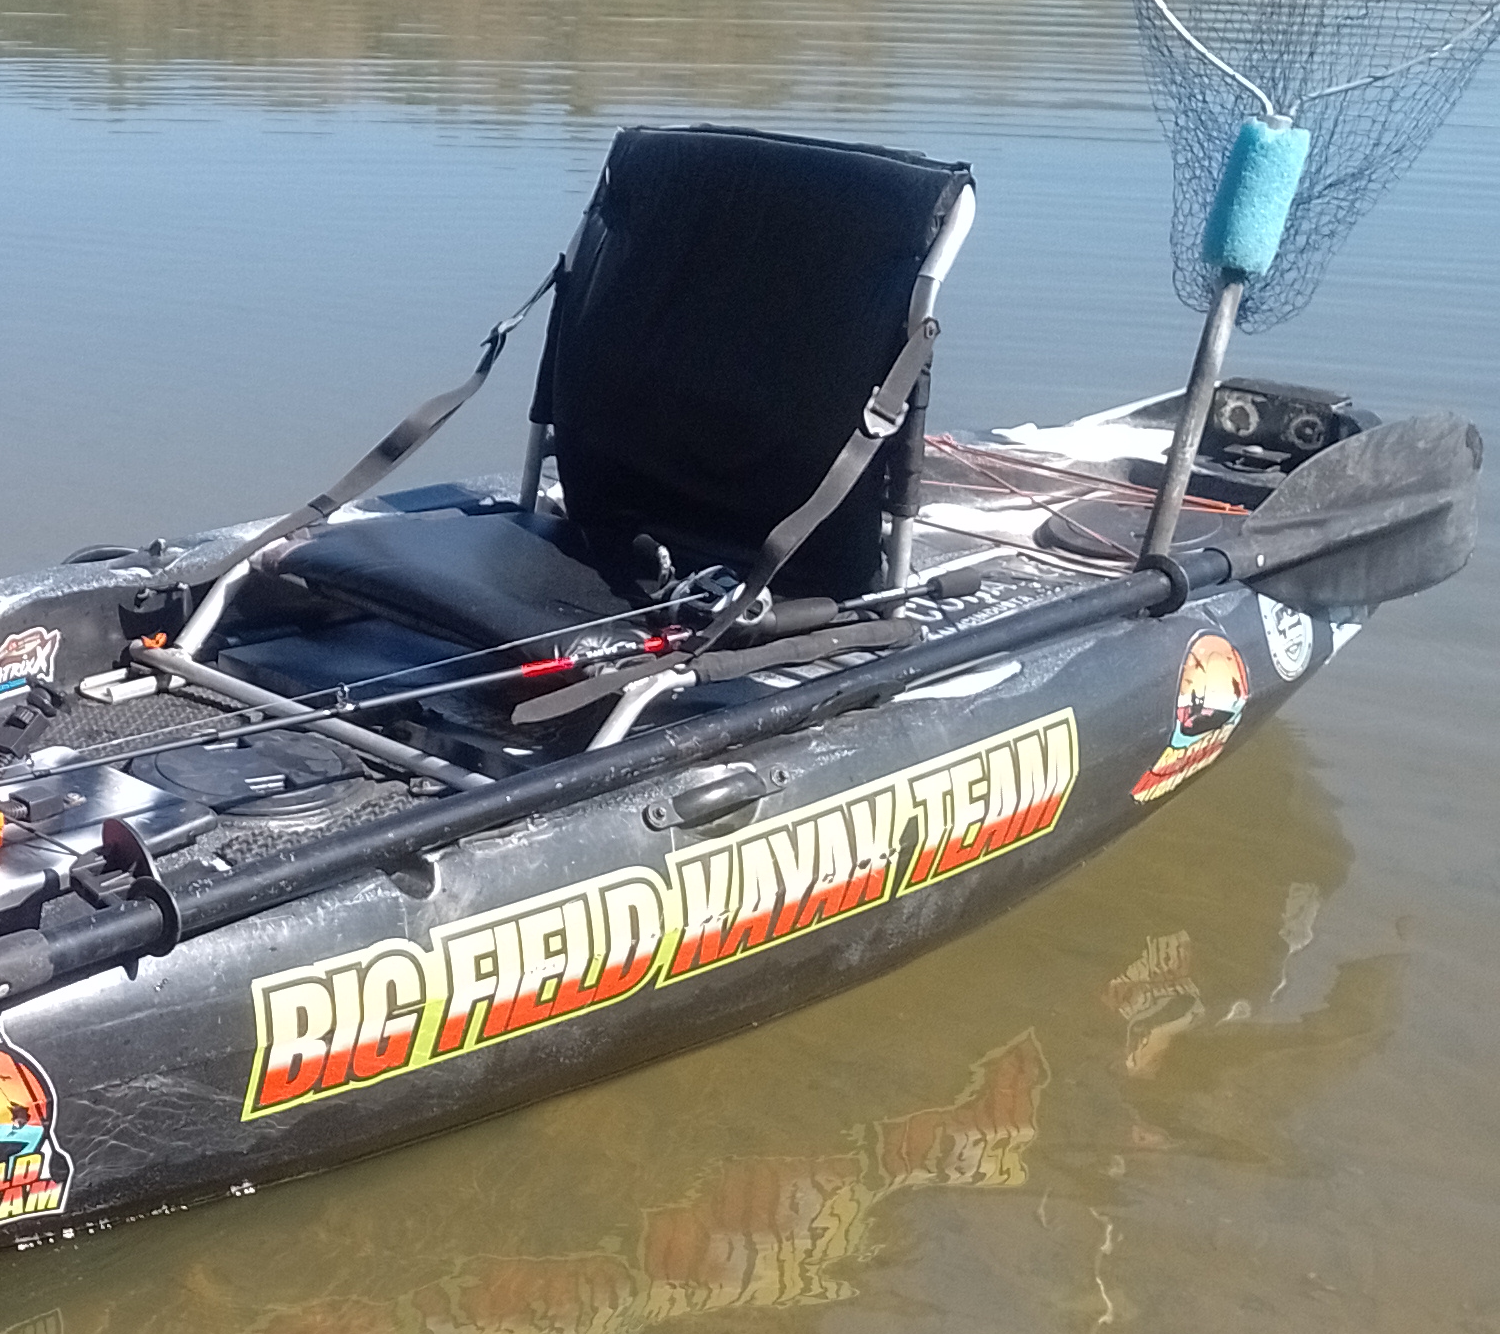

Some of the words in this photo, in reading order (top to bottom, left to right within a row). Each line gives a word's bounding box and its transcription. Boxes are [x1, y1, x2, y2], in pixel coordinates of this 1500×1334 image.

[258, 973, 424, 1107] BIG
[436, 880, 664, 1050] FIELD
[669, 791, 900, 976] KAYAK
[907, 724, 1073, 882] TEAM
